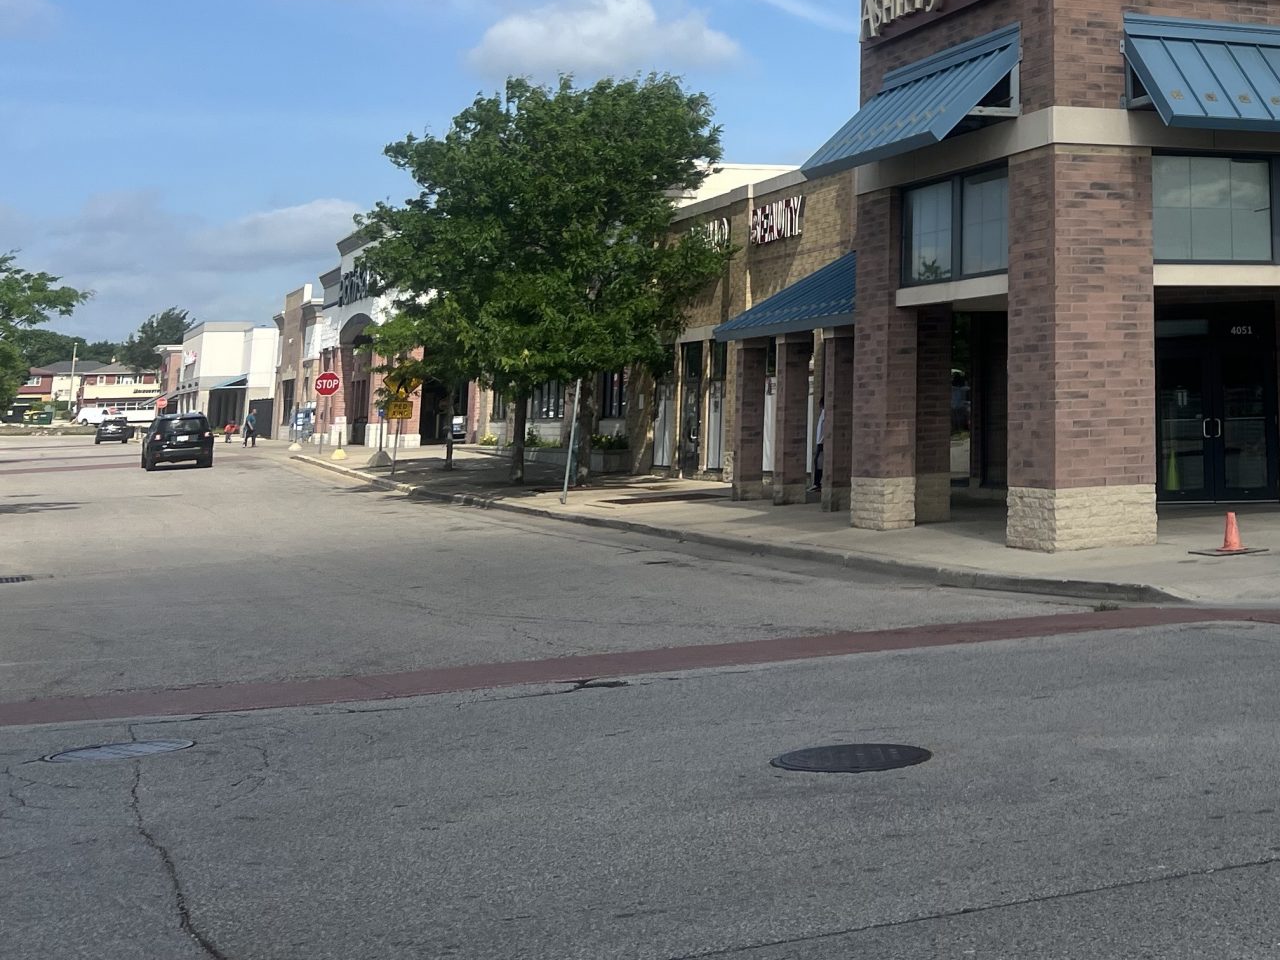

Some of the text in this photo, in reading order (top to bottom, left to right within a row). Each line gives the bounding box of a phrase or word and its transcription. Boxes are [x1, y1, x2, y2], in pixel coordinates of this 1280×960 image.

[750, 194, 803, 245] BEAUTY
[1230, 325, 1253, 336] 4051
[316, 380, 339, 389] STOP
